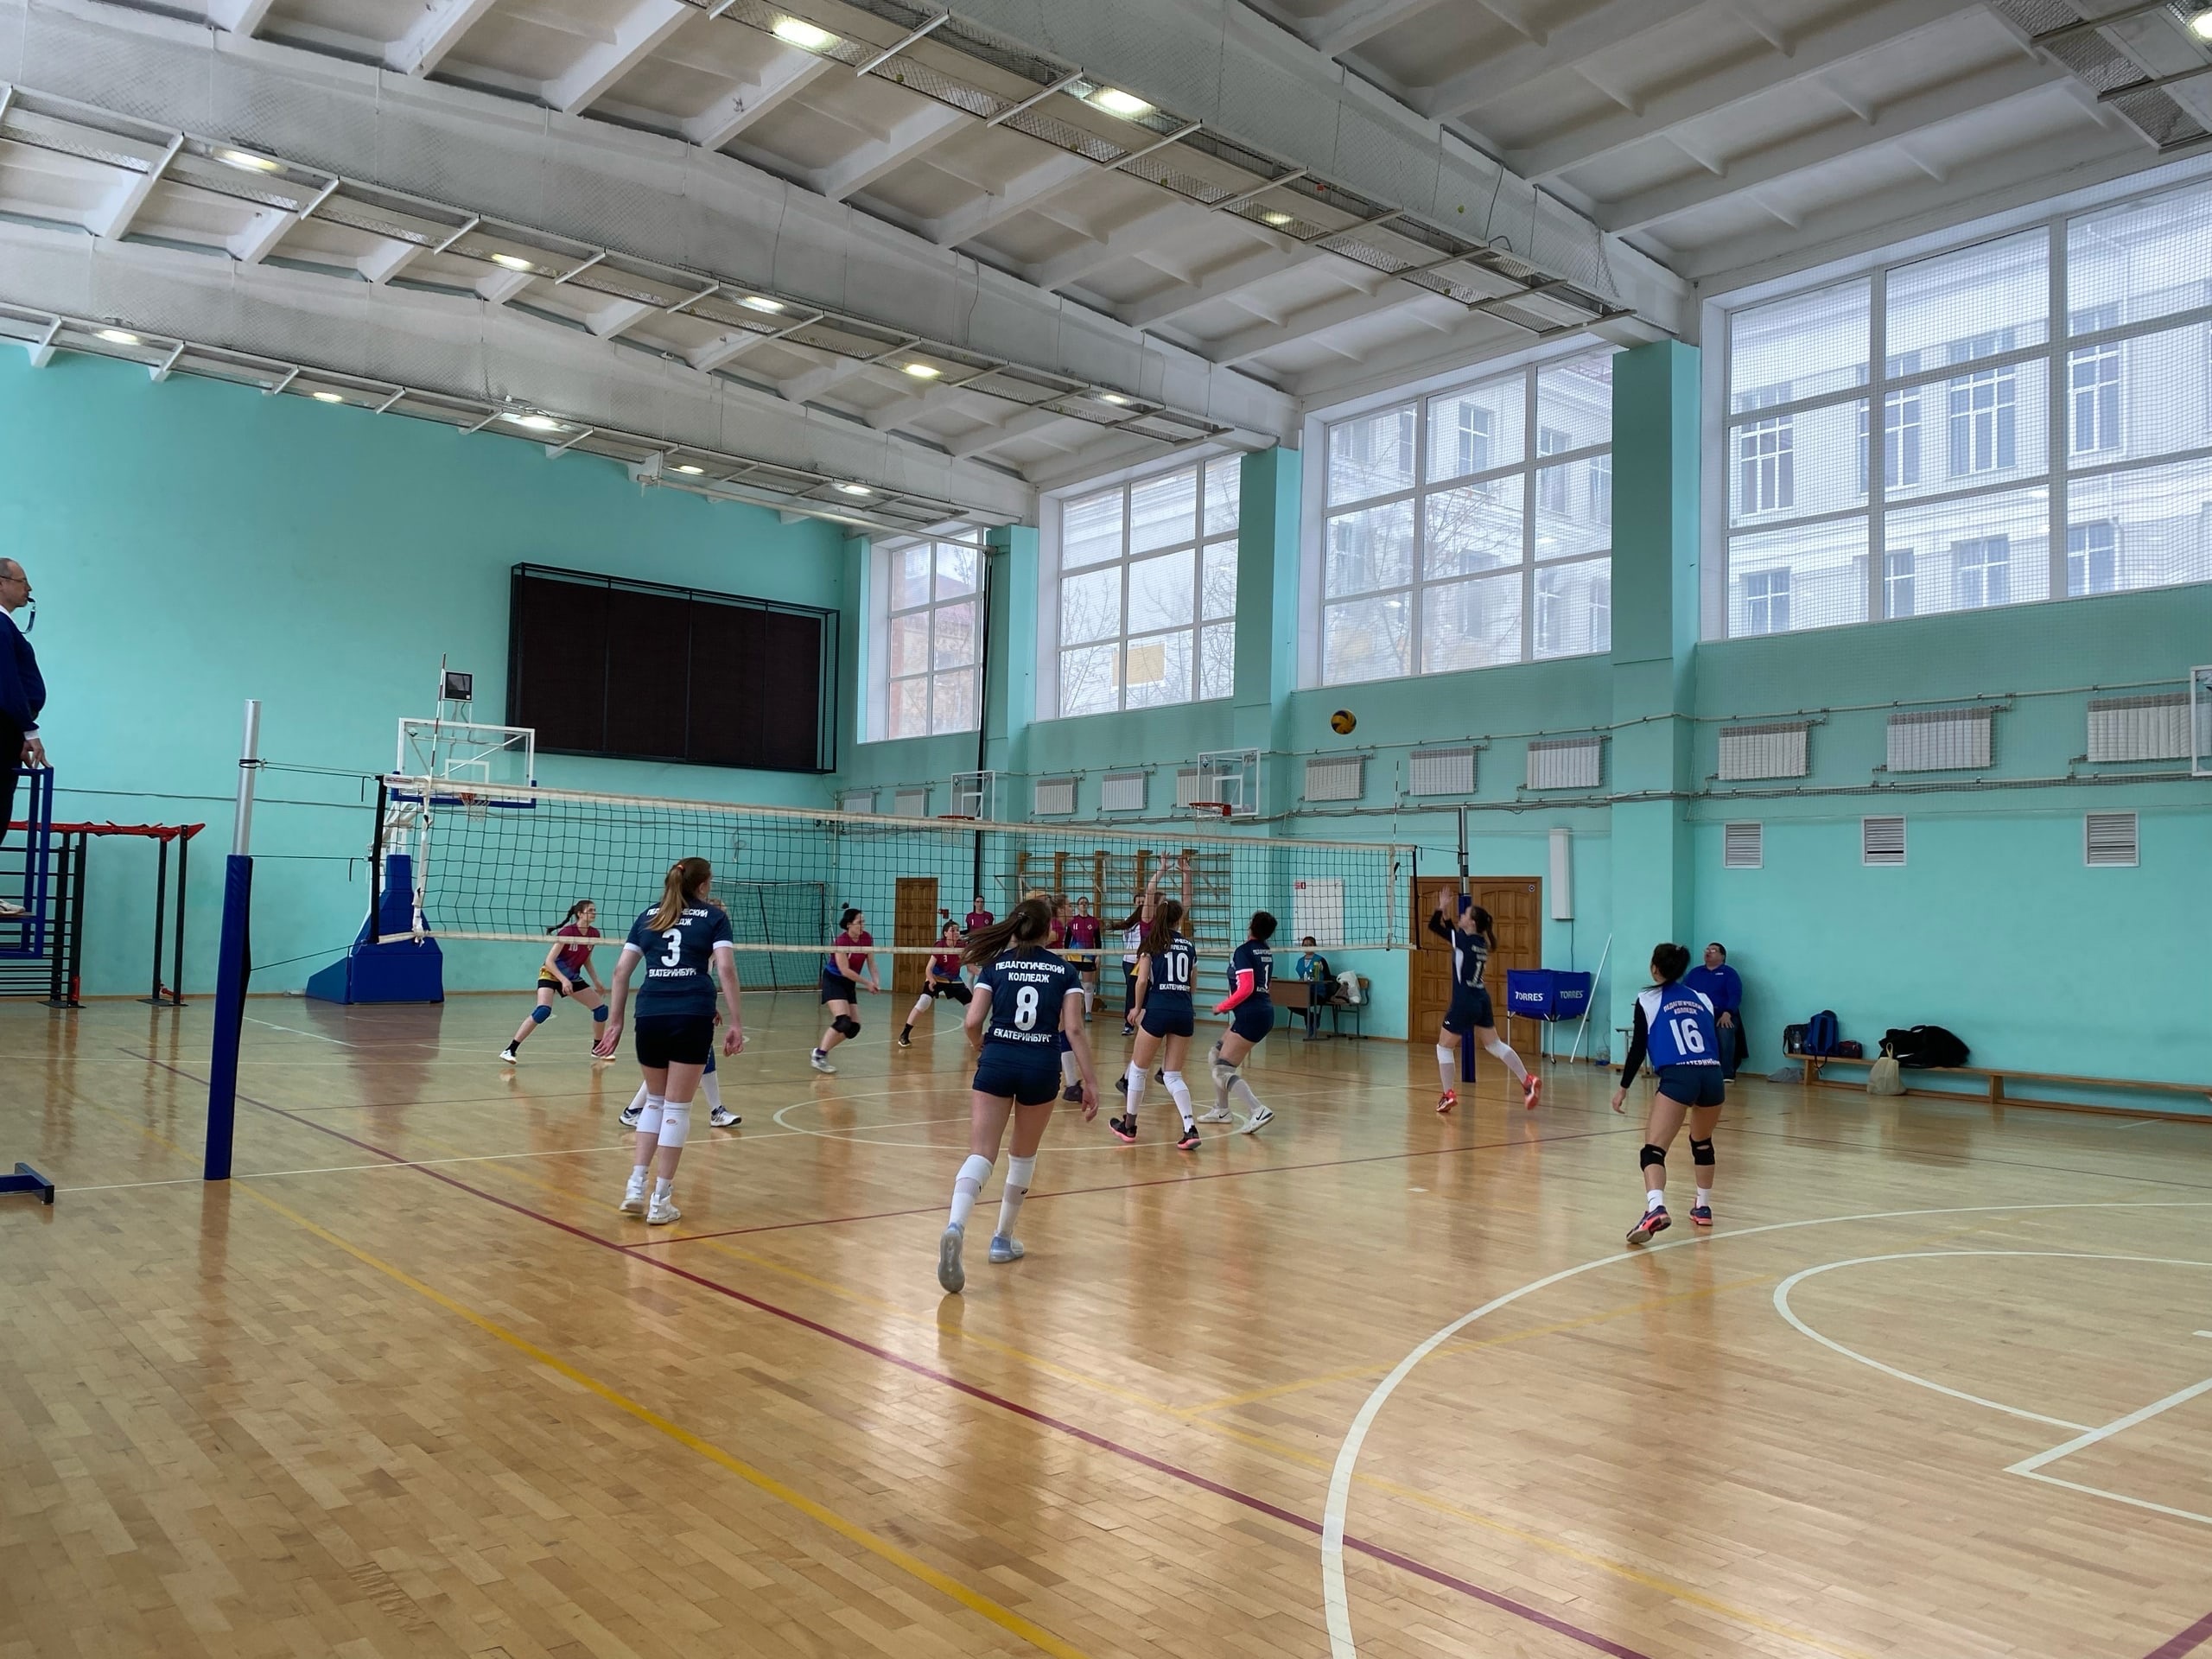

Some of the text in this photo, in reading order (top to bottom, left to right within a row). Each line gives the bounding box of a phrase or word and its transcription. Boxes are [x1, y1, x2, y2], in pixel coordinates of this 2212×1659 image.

[661, 928, 682, 967] 3
[943, 954, 948, 963] 3
[995, 961, 1065, 975] ПЕДАГОГИЧЕСКИЙ
[1164, 951, 1189, 983] 10
[1007, 972, 1050, 983] КОЛЛЕДЖ
[1264, 963, 1270, 989] 1
[1515, 991, 1543, 1001] TORRES
[1560, 990, 1584, 999] TORRES
[1014, 986, 1039, 1032] 8
[994, 1028, 1052, 1042] ЕКАТЕРИНБУРГ
[1669, 1018, 1705, 1056] 16
